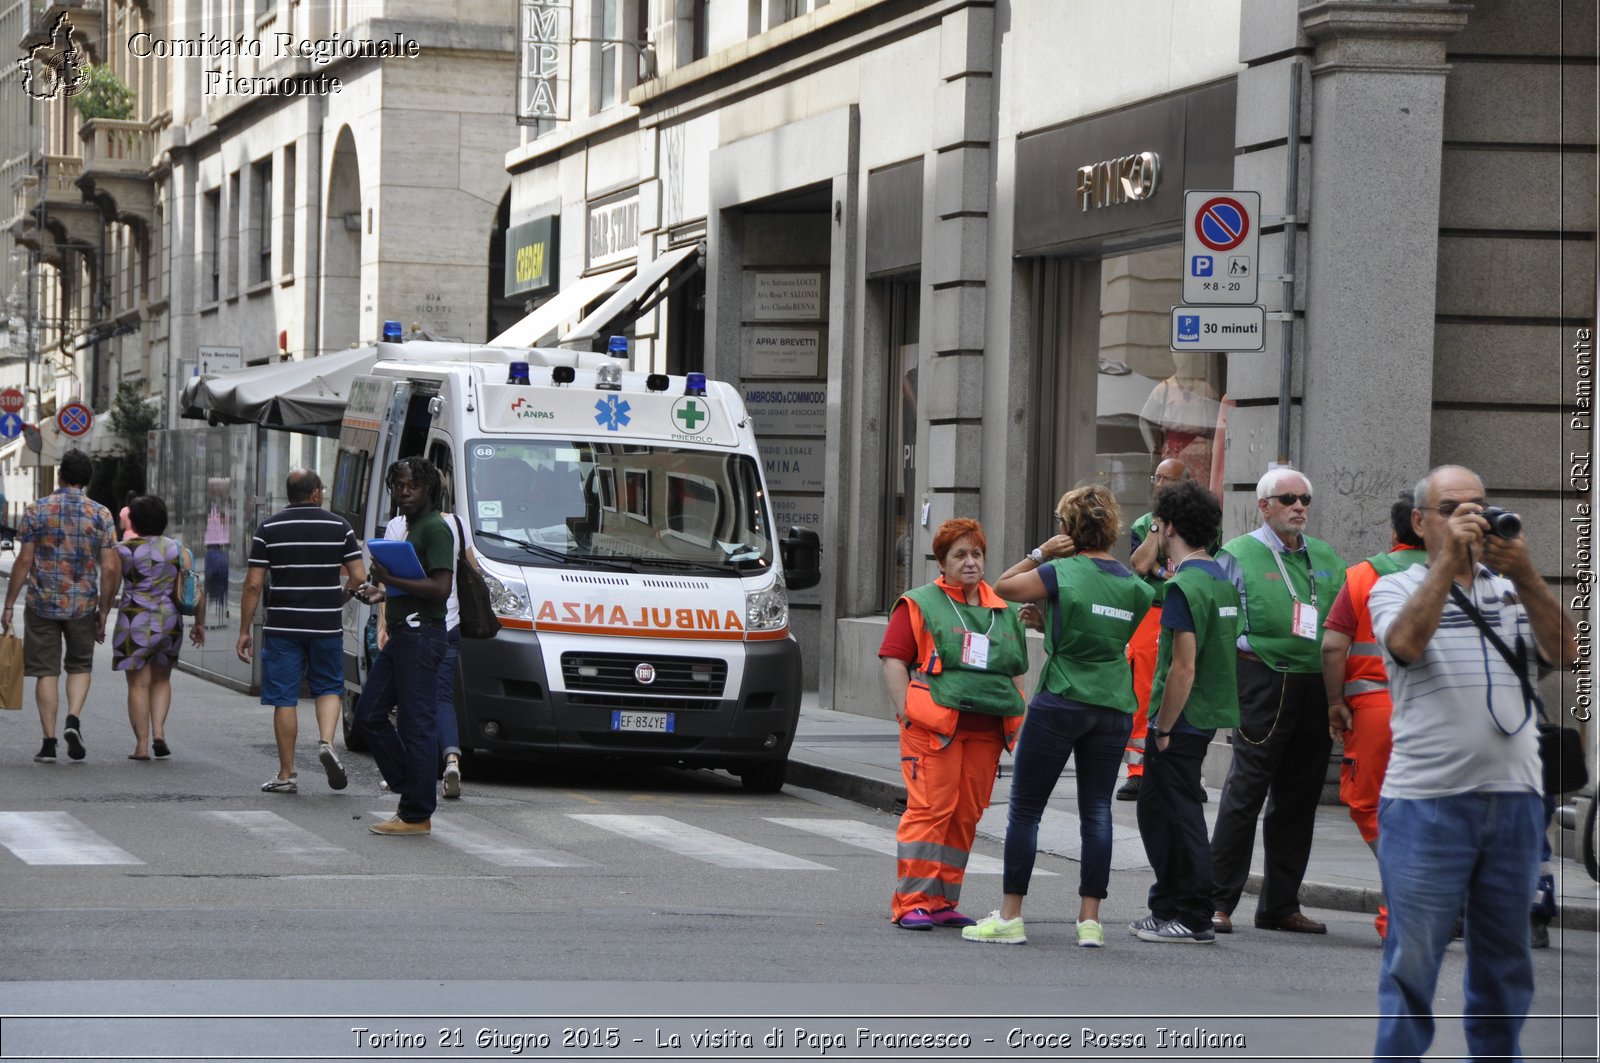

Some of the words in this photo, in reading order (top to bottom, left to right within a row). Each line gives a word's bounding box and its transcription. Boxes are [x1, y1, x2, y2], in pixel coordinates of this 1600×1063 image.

[526, 0, 560, 116] MPA
[1076, 152, 1161, 212] PINKO
[516, 241, 545, 284] CREDEM
[1204, 323, 1217, 334] 30
[1222, 322, 1258, 334] minuti
[0, 396, 23, 406] STOP
[746, 391, 782, 403] AMBROSIO
[787, 392, 825, 403] COMMODO
[523, 411, 554, 419] ANPAS
[671, 434, 713, 443] PINEROLO
[766, 460, 800, 472] MINA
[639, 668, 651, 680] FIAT
